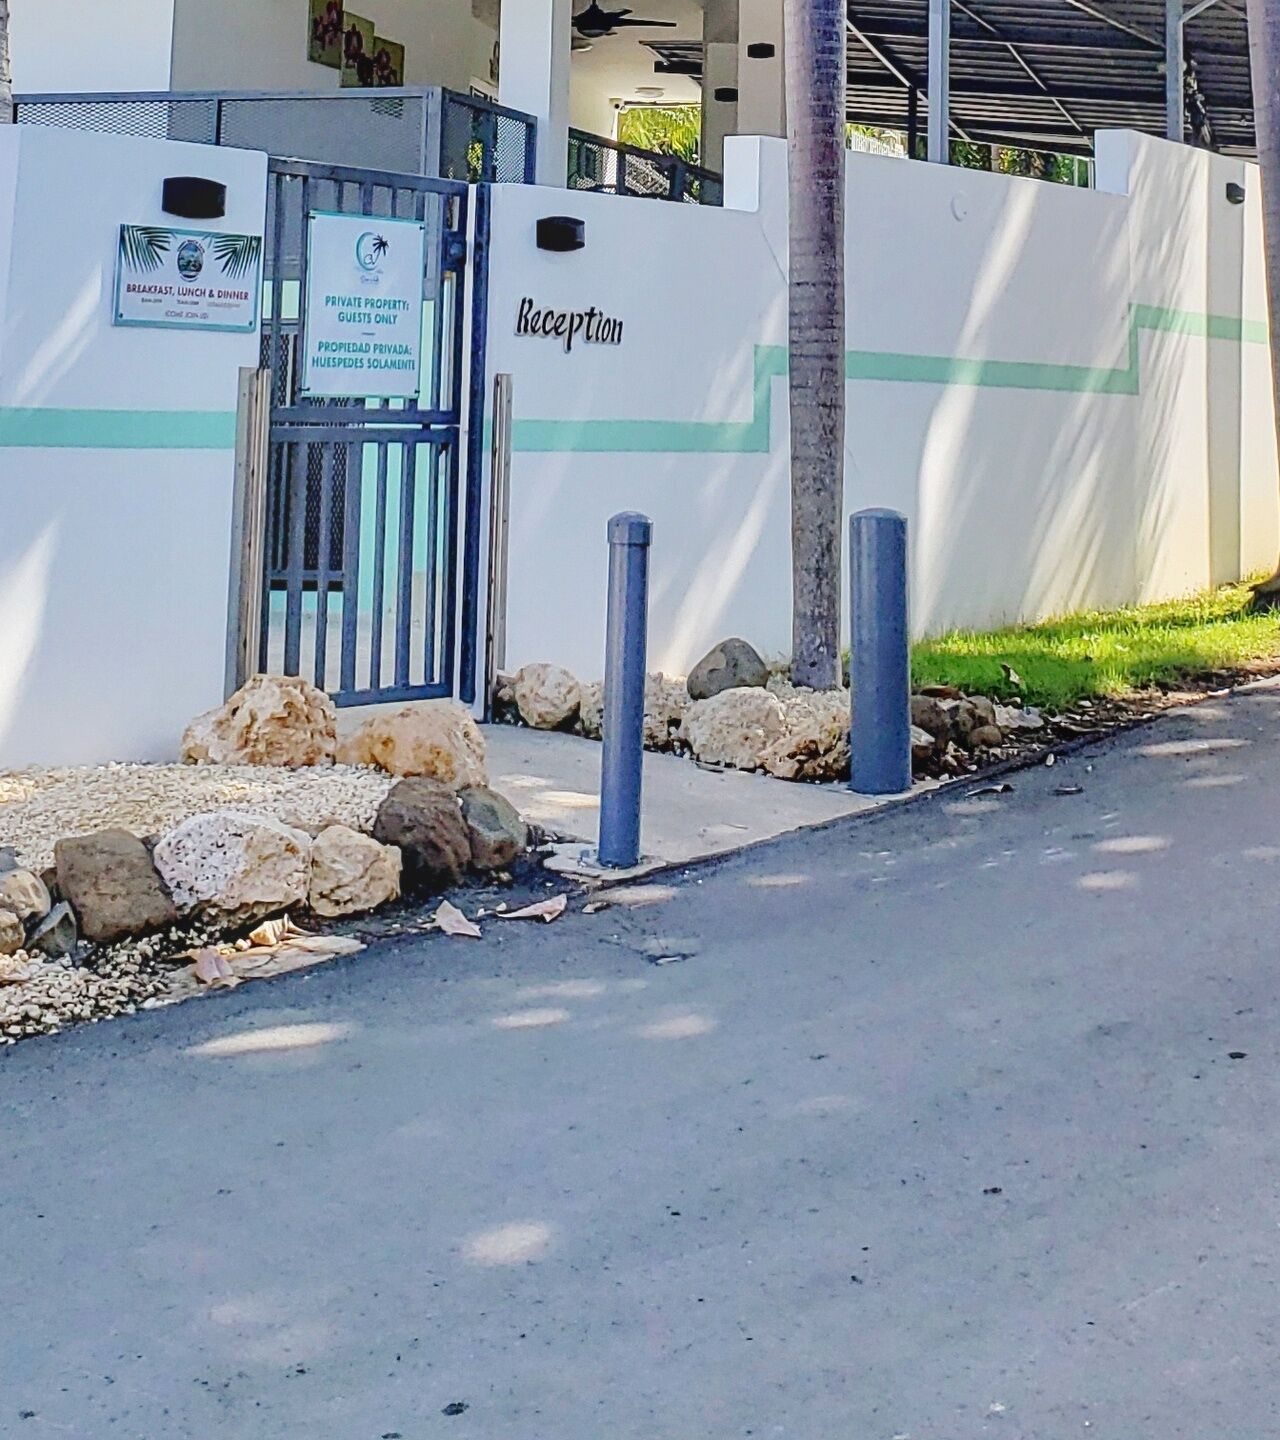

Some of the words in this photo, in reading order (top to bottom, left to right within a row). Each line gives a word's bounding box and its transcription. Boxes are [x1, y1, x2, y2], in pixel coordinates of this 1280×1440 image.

[126, 283, 175, 297] BREAKFAST,
[177, 286, 206, 298] LUNCH
[208, 288, 215, 299] &
[217, 290, 249, 300] DINNER
[325, 295, 362, 308] PRIVATE
[338, 311, 372, 324] GUESTS
[374, 313, 398, 325] ONLY
[516, 297, 623, 353] Reception
[318, 341, 370, 354] PROPIEDAD
[373, 343, 412, 355] PRIVADA:
[312, 356, 364, 369] HUESPEDES
[367, 358, 415, 371] SOLAMENTE
